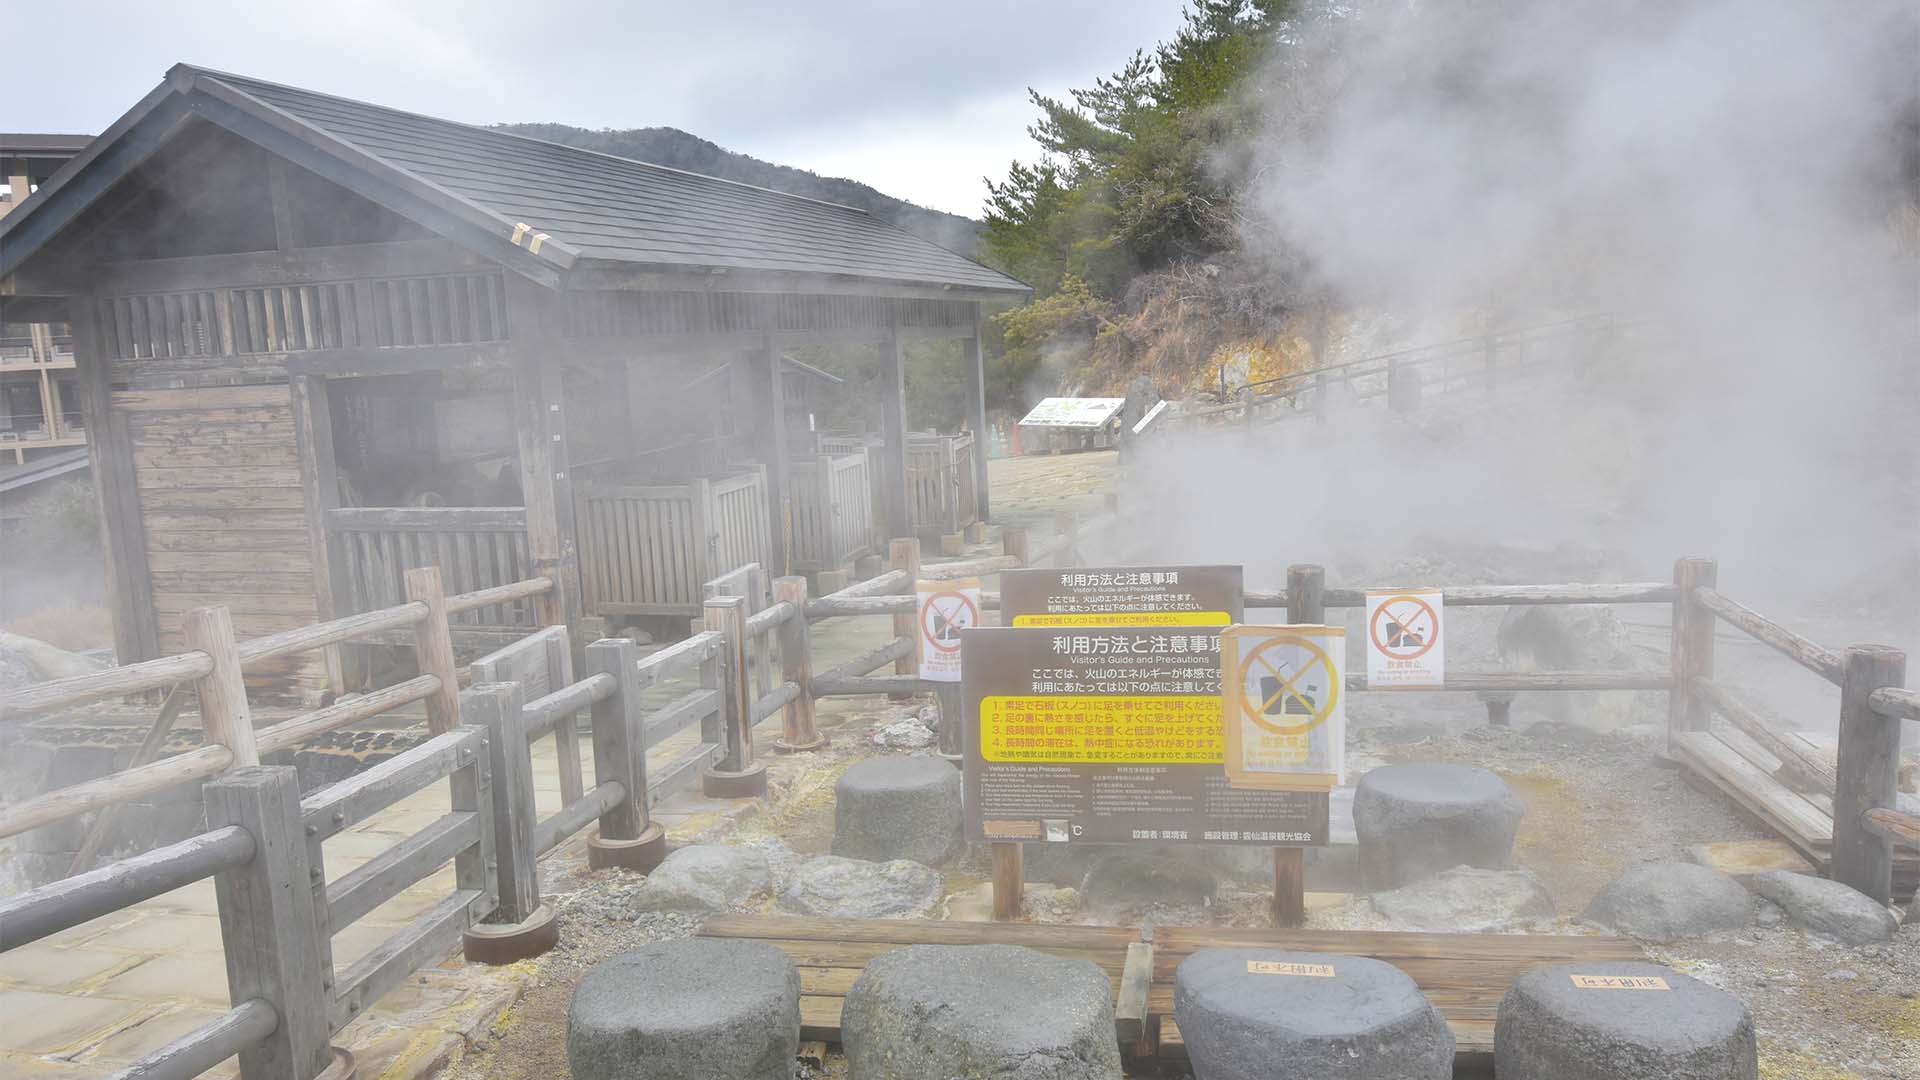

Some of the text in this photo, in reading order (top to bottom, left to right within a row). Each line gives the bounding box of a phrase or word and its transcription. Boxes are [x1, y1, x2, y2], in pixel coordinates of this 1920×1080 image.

[1061, 571, 1179, 587] 利用方法と注意事項
[1053, 635, 1222, 654] 利用方法と注意事項
[1071, 656, 1211, 665] Visitor's Guide and Precautions
